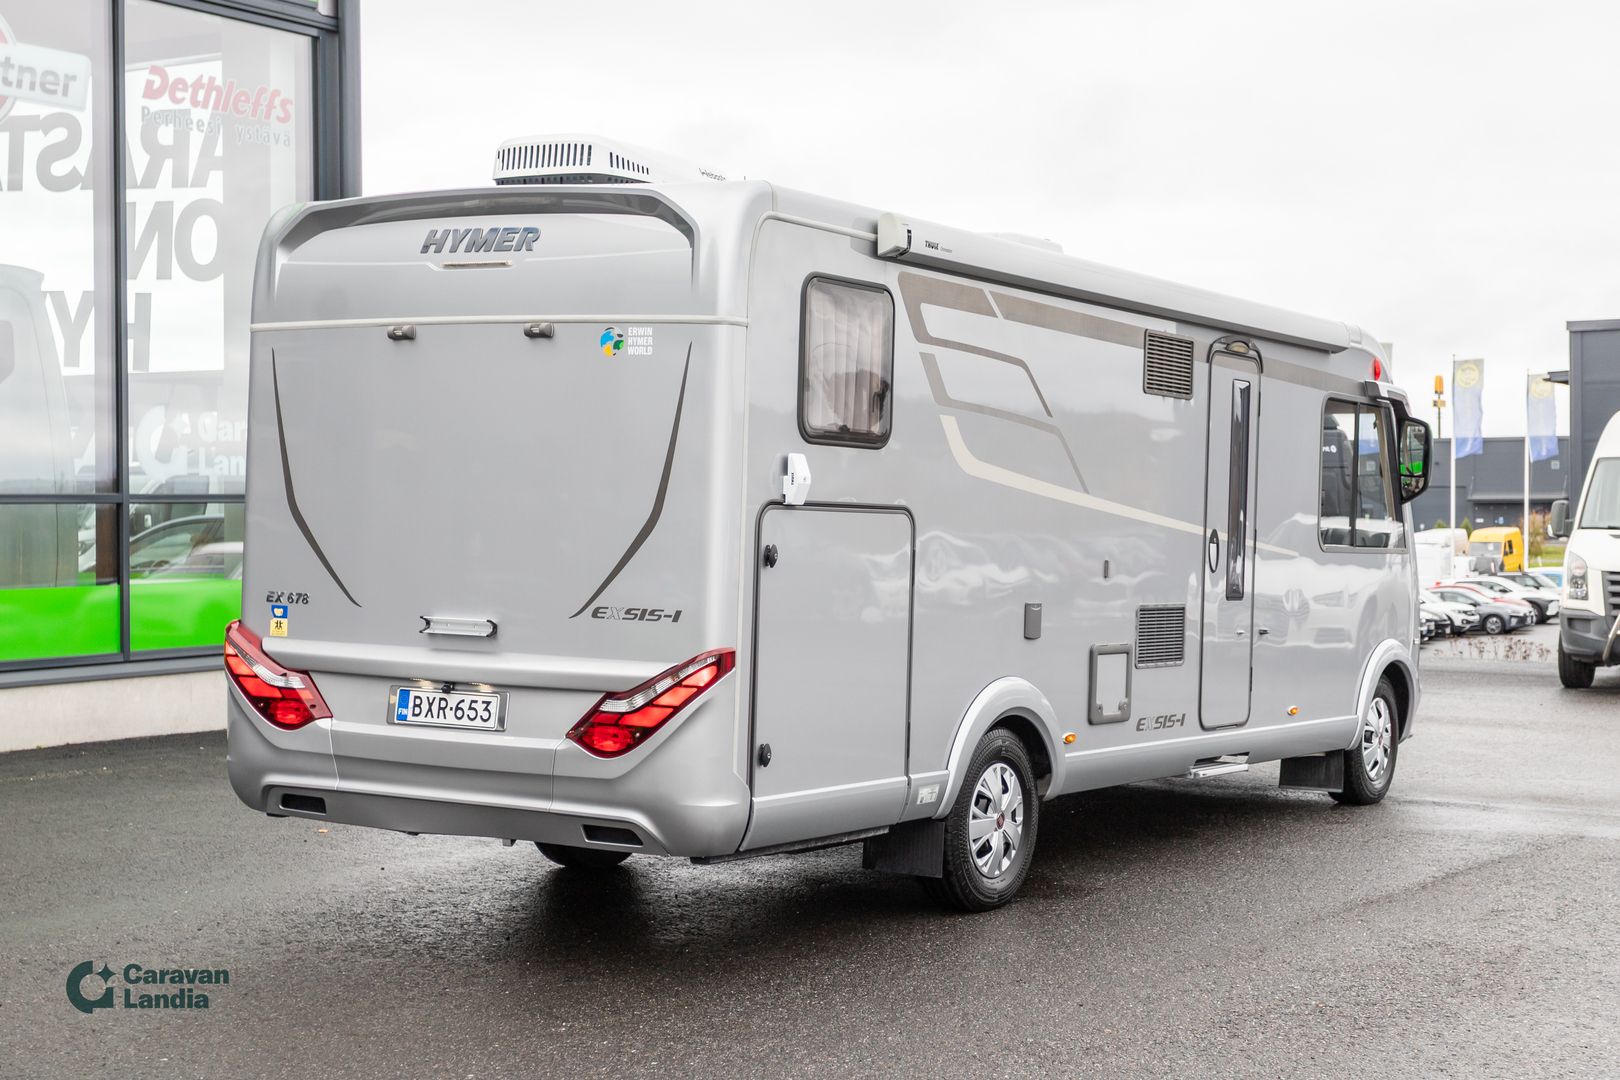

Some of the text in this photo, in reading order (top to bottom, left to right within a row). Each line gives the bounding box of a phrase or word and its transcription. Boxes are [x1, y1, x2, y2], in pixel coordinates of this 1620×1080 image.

[142, 65, 294, 124] Dethleffs
[420, 227, 541, 254] HYMER
[628, 327, 653, 336] ERWIN
[628, 337, 653, 346] HYMER
[628, 346, 653, 356] WORLD
[266, 591, 309, 605] EX 678
[591, 606, 683, 623] EXSIS-I
[412, 695, 492, 723] BXR-653
